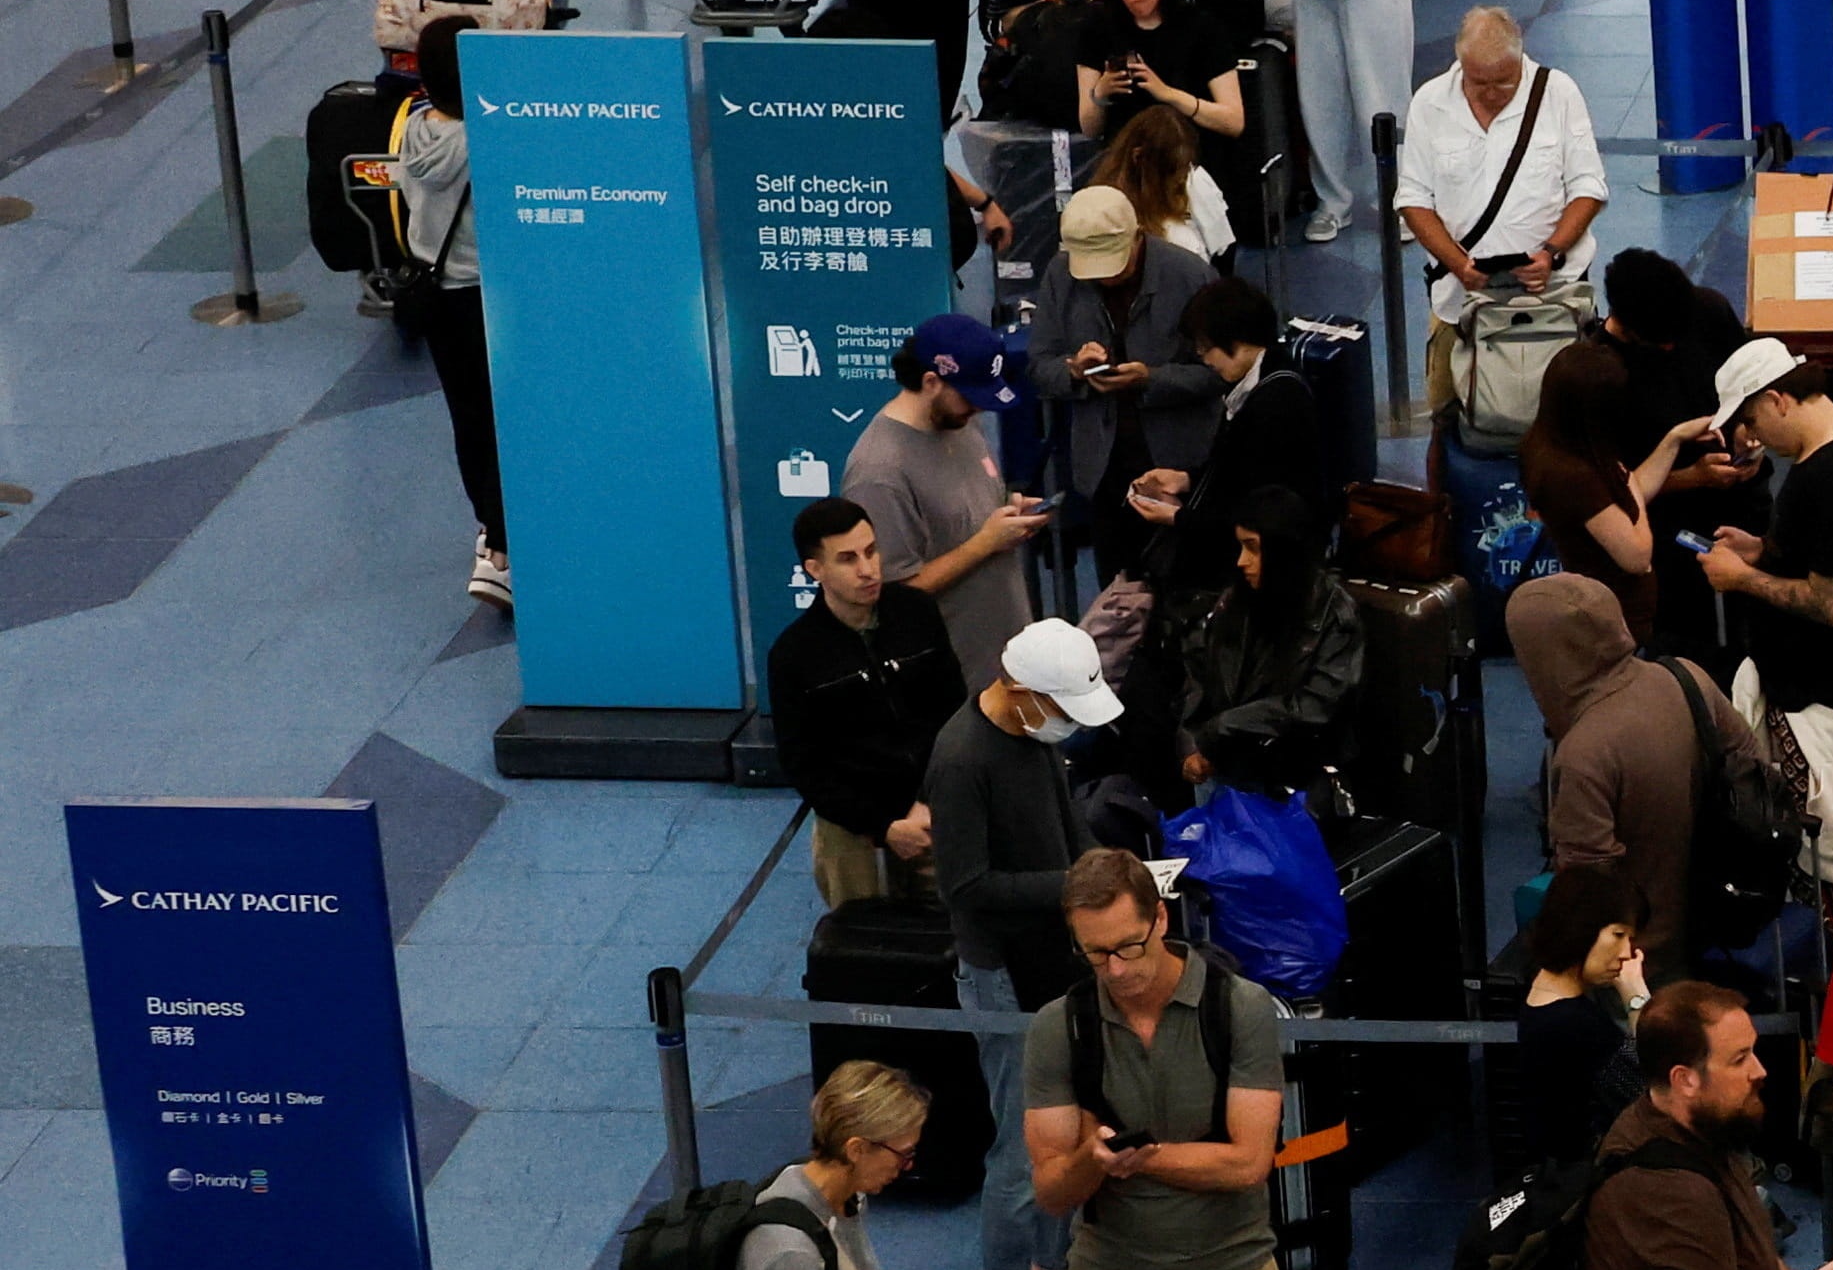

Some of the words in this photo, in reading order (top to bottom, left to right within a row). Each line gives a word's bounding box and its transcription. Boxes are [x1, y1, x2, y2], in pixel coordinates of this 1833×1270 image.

[505, 101, 582, 119] CATHAY
[587, 103, 661, 120] PACIFIC
[748, 101, 827, 118] CATHAY
[831, 102, 905, 119] PACIFIC
[755, 173, 796, 193] Self
[800, 175, 889, 194] check-in
[514, 185, 588, 203] Premium
[591, 186, 668, 206] Economy
[757, 195, 796, 214] and
[800, 195, 840, 218] bag
[843, 196, 893, 218] drop
[758, 225, 933, 248] 自助辦理登機手續
[760, 251, 869, 272] 及行李寄艙
[835, 324, 890, 337] Check-in
[837, 336, 865, 350] print
[866, 337, 890, 350] bag
[1497, 558, 1564, 577] TRVE
[131, 891, 235, 911] CATHAY
[241, 893, 340, 913] PACIFIC
[146, 995, 246, 1017] Business
[149, 1025, 196, 1046] 商務
[157, 1089, 221, 1104] Diamond
[236, 1091, 271, 1105] Gold
[286, 1092, 326, 1105] Silver
[195, 1173, 249, 1190] Priority
